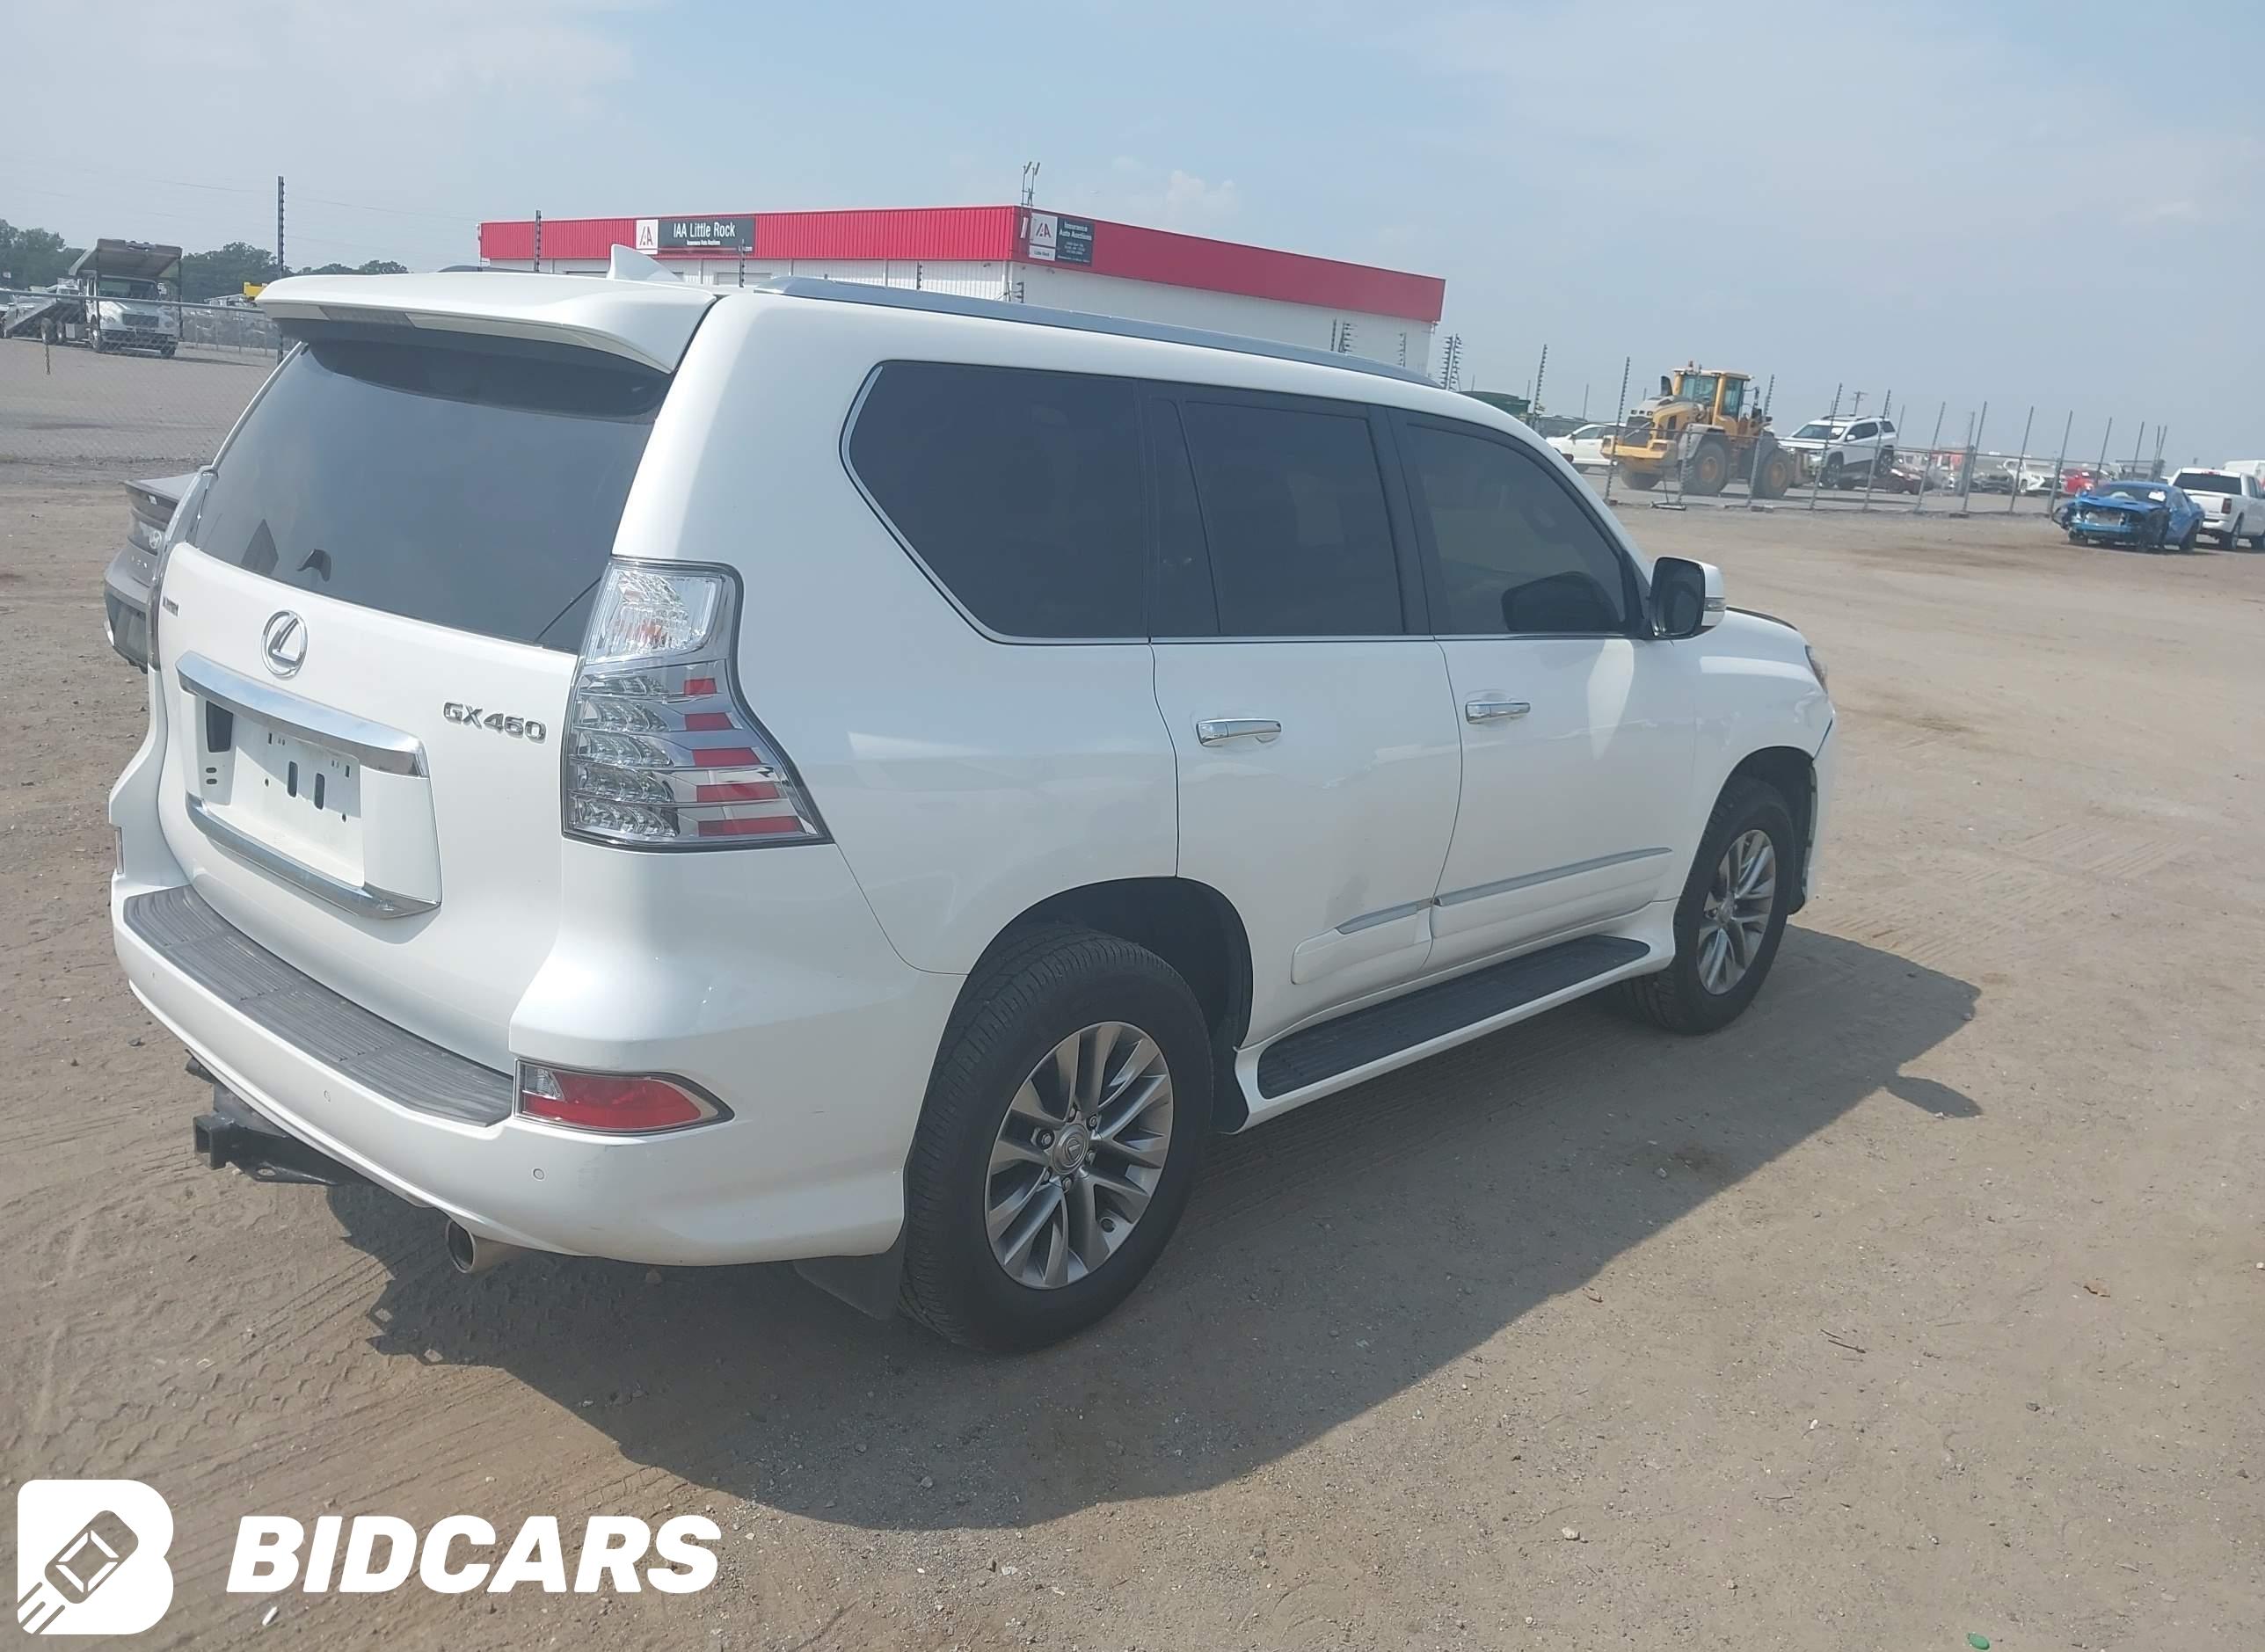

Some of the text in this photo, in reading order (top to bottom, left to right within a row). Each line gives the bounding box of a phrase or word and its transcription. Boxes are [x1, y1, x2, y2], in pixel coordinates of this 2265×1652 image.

[673, 222, 736, 238] IAA Little Rock
